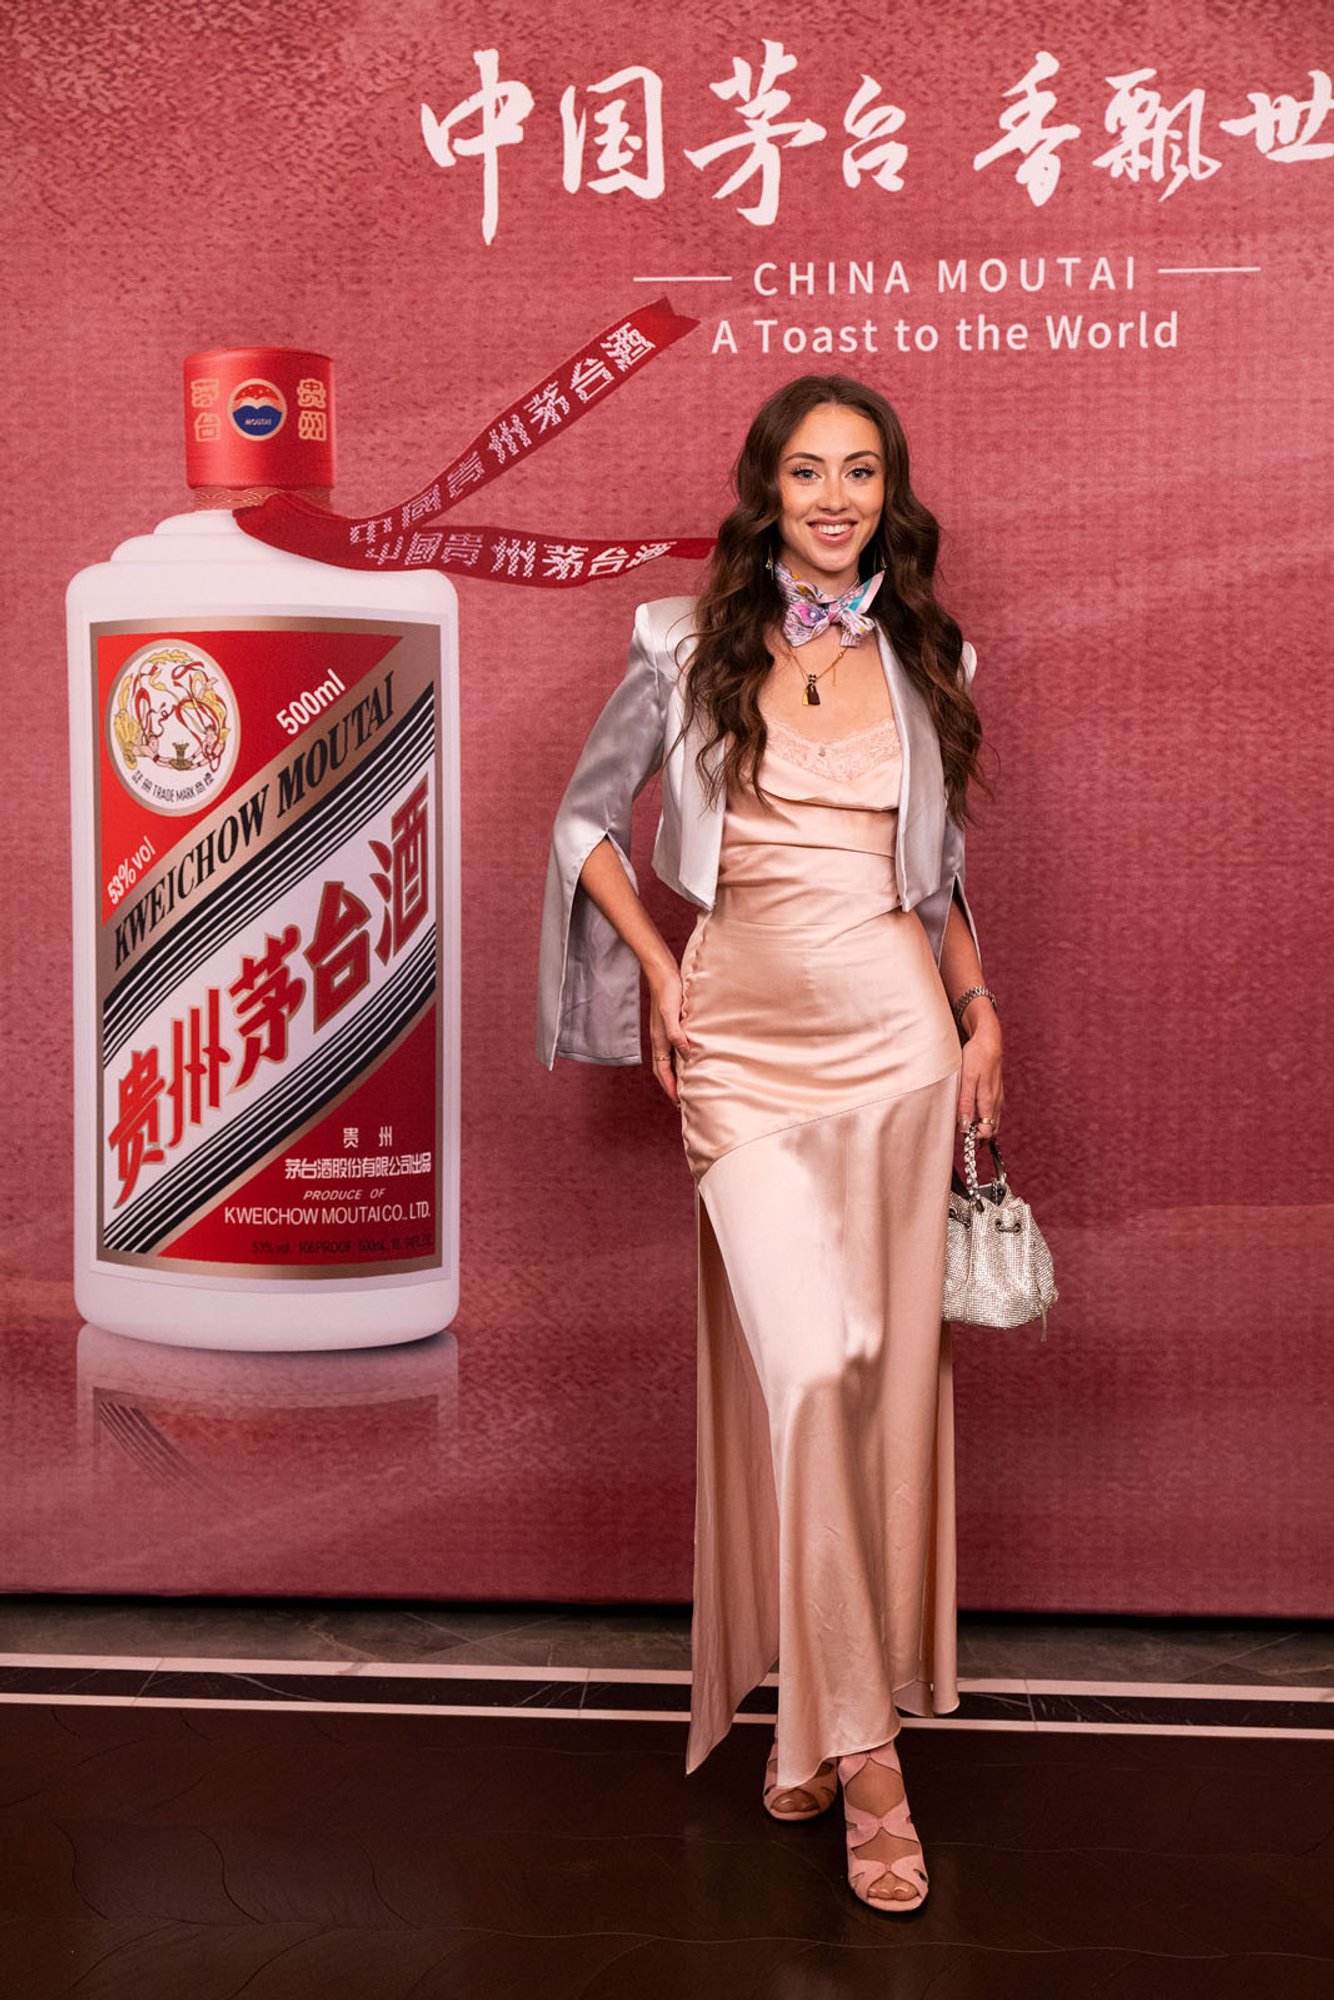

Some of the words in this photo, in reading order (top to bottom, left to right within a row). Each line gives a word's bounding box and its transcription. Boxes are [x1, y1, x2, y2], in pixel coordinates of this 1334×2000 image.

[420, 39, 909, 246] 中国茅台
[753, 260, 910, 297] CHINA
[937, 255, 1135, 294] MOUTAI
[710, 319, 739, 355] A
[753, 319, 879, 354] Toast
[894, 319, 939, 353] to
[955, 313, 1029, 351] the
[1045, 310, 1178, 350] World
[275, 667, 347, 736] 500ml
[113, 784, 270, 972] KWEICHOW
[277, 670, 395, 819] MOUTAI
[107, 772, 429, 1211] 贵州茅台酒
[224, 1206, 319, 1226] KWEICHOW
[321, 1205, 381, 1225] MOUTAI
[409, 1200, 431, 1220] LTD.
[303, 1188, 363, 1201] PRODUCE
[369, 1187, 387, 1199] OF
